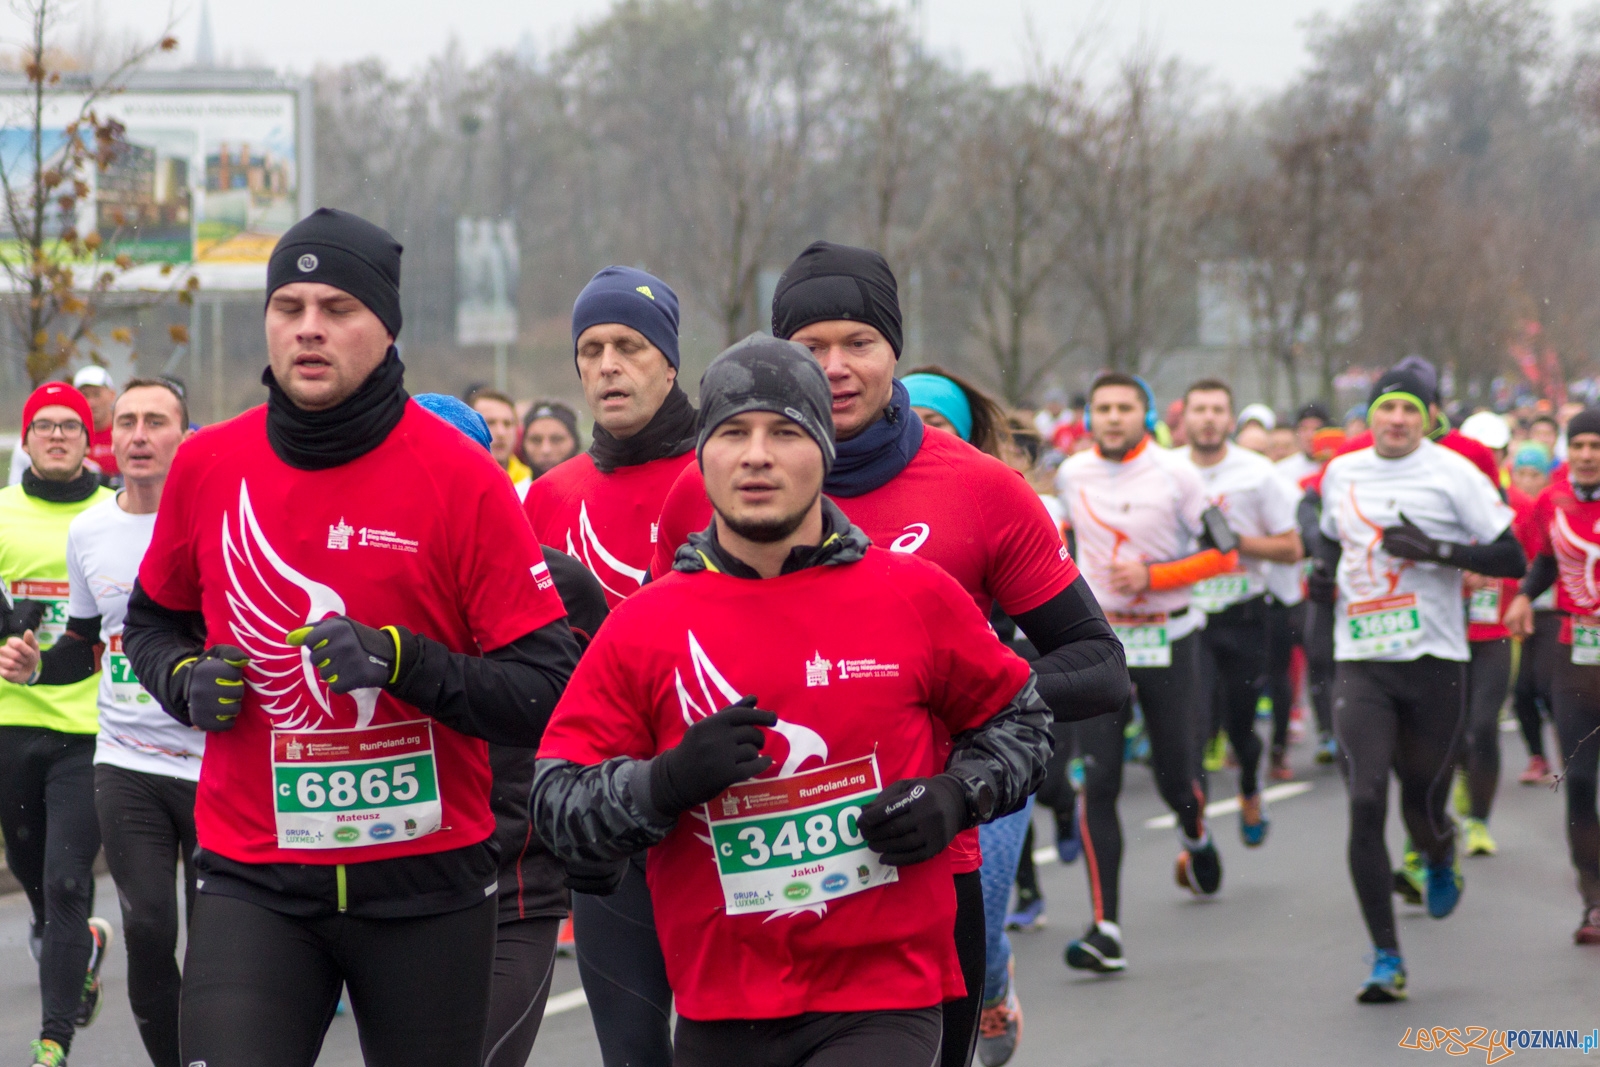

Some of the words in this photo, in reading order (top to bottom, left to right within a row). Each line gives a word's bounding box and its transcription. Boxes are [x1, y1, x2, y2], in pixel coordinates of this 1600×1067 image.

[358, 527, 368, 546] 1
[837, 659, 849, 679] 1
[360, 736, 420, 751] RunPoland.org
[296, 763, 419, 809] 6865
[799, 774, 865, 798] RunPoland.org
[337, 813, 380, 822] Mateusz
[286, 829, 310, 837] GRUPA
[737, 805, 865, 866] 3480
[791, 864, 825, 878] Jakub
[733, 891, 759, 900] GRUPA
[735, 898, 765, 907] LUXMED
